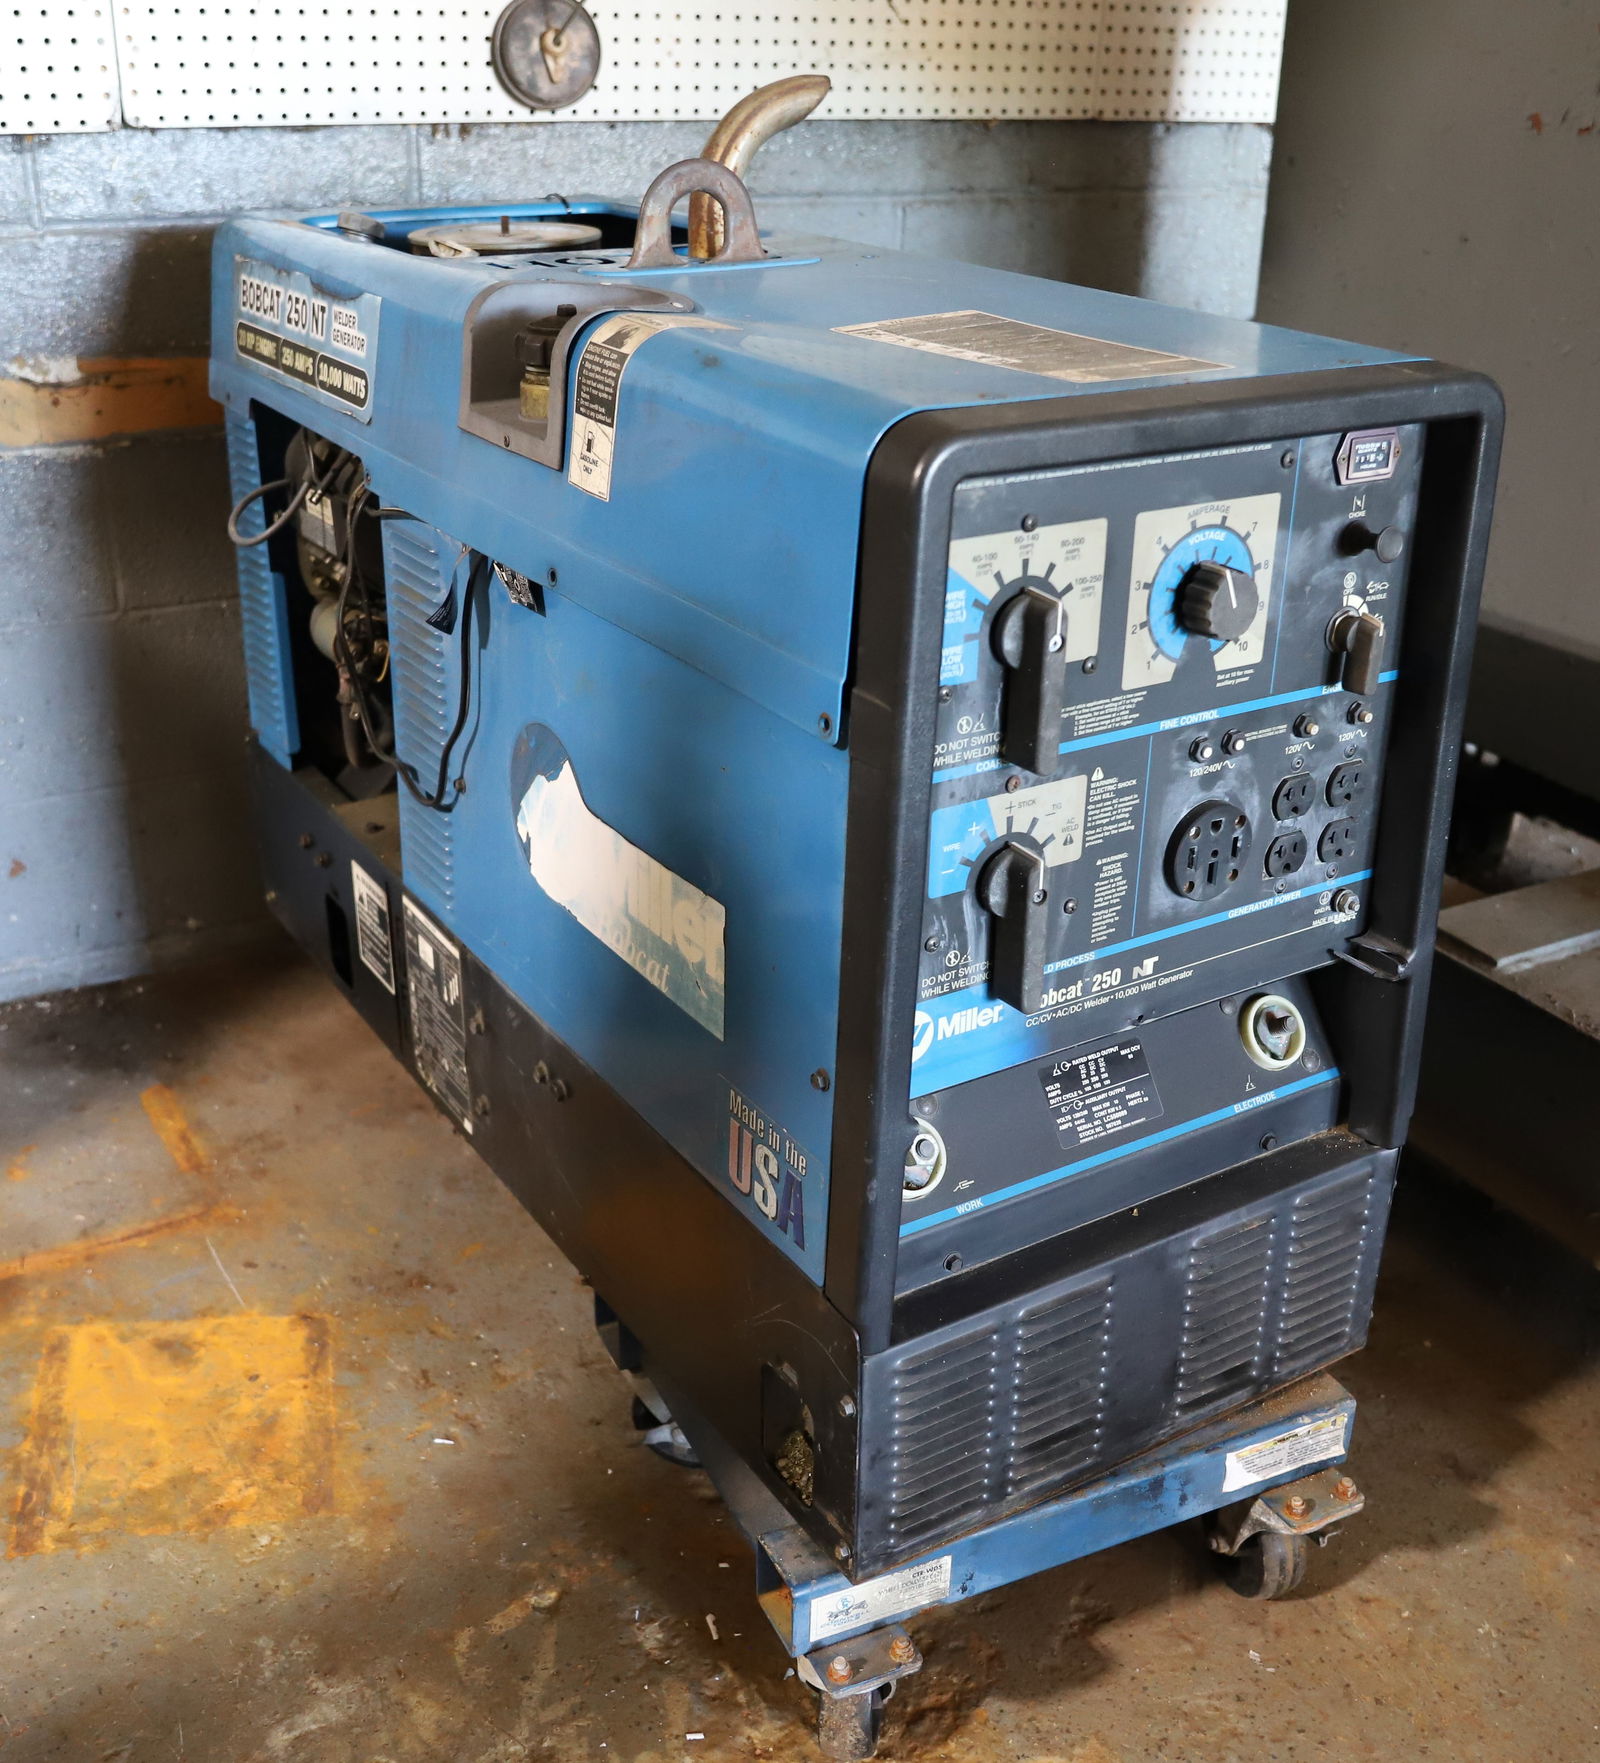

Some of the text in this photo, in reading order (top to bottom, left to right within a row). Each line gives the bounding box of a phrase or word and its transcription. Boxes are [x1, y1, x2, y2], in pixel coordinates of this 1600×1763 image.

[242, 279, 326, 337] BOBCAT 250 NT
[334, 309, 356, 328] WELDER
[333, 329, 365, 352] GENERATOR
[294, 352, 314, 376] AMPS
[319, 362, 365, 400] 10,000 WATTS
[580, 452, 599, 468] GASOLINE
[583, 465, 593, 475] ONLY
[1187, 504, 1231, 520] AMPERAGE
[1348, 510, 1367, 519] CHOKE
[1252, 522, 1259, 532] 7
[1188, 531, 1226, 545] VOLTAGE
[1263, 560, 1269, 570] 8
[1134, 581, 1141, 591] 3
[1131, 624, 1138, 635] 2
[1238, 641, 1248, 652] 10
[1160, 710, 1220, 730] FINE CONTROL
[948, 739, 969, 751] NOT
[970, 732, 1001, 747] SWITC
[1339, 732, 1356, 742] 120V
[963, 744, 1001, 759] WELDIN
[1285, 744, 1302, 755] 120V
[1190, 762, 1222, 777] 120/240V
[1090, 779, 1137, 795] ELECTRIC SHOCK
[1018, 799, 1037, 809] STICK
[1062, 824, 1079, 833] WELD
[1102, 862, 1122, 872] SHOCK
[1228, 890, 1302, 919] GENERATOR POWER
[1055, 952, 1095, 969] PROCESS
[921, 976, 936, 988] DO
[937, 970, 957, 983] NOT
[1039, 956, 1159, 1009] obcat 250 NT
[1140, 981, 1157, 992] Watt
[1158, 969, 1194, 986] Generator
[921, 984, 949, 999] WHILE
[937, 1004, 1003, 1041] Miller
[1071, 1046, 1119, 1066] RATED WELD OUTPUT
[1120, 1044, 1141, 1055] MAX OCV
[1045, 1083, 1061, 1092] VOLTS
[1047, 1090, 1061, 1098] AMPS
[1085, 1086, 1126, 1105] AUXILIARY OUTPUT
[1049, 1096, 1062, 1105] DUTY
[1063, 1092, 1078, 1100] CYCLE
[1233, 1091, 1277, 1113] ELECTRODE
[1056, 1115, 1072, 1124] VOLTS
[1126, 1091, 1141, 1101] PHASE
[1059, 1122, 1073, 1131] AMPS
[1094, 1110, 1108, 1119] CONT
[1128, 1097, 1143, 1107] HERTZ
[729, 1089, 807, 1176] Made in the
[1077, 1122, 1094, 1132] SERIAL
[1079, 1129, 1095, 1139] STOCK
[728, 1117, 806, 1252] USA
[955, 1197, 984, 1215] WORK
